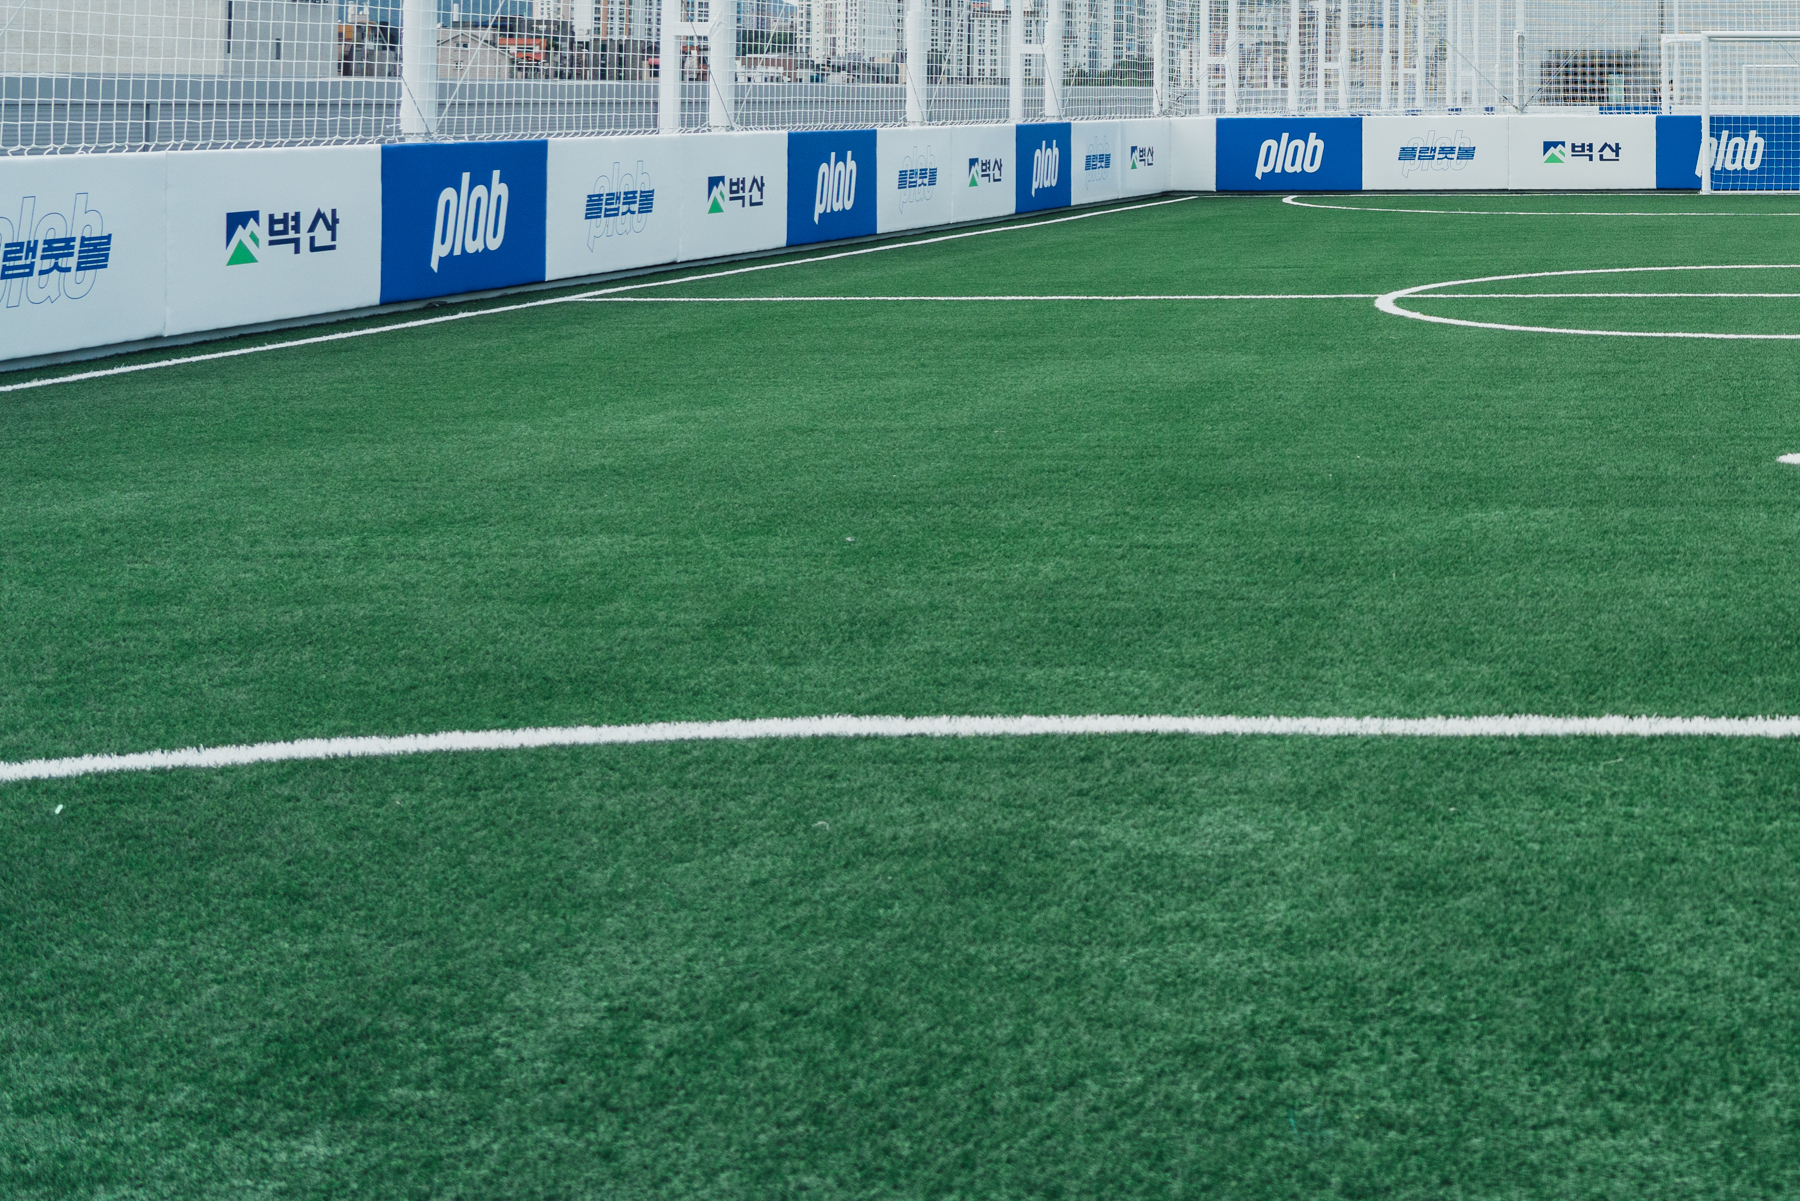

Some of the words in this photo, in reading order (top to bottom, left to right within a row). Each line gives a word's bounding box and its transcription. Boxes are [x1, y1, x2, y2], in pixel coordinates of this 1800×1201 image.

[1032, 139, 1059, 197] plab
[1084, 153, 1111, 171] 플랩풋볼
[1139, 146, 1154, 167] 벽산
[1255, 132, 1325, 180] plab
[1398, 146, 1476, 161] 플랩풋볼
[1570, 142, 1622, 162] 벽산
[898, 167, 938, 190] 플랩풋볼
[980, 158, 1002, 183] 벽산
[729, 175, 765, 208] 벽산
[814, 150, 857, 225] plab
[584, 188, 655, 221] 플랩풋볼
[267, 207, 339, 255] 벽산
[431, 170, 509, 273] plab
[0, 233, 112, 280] 랩풋볼
